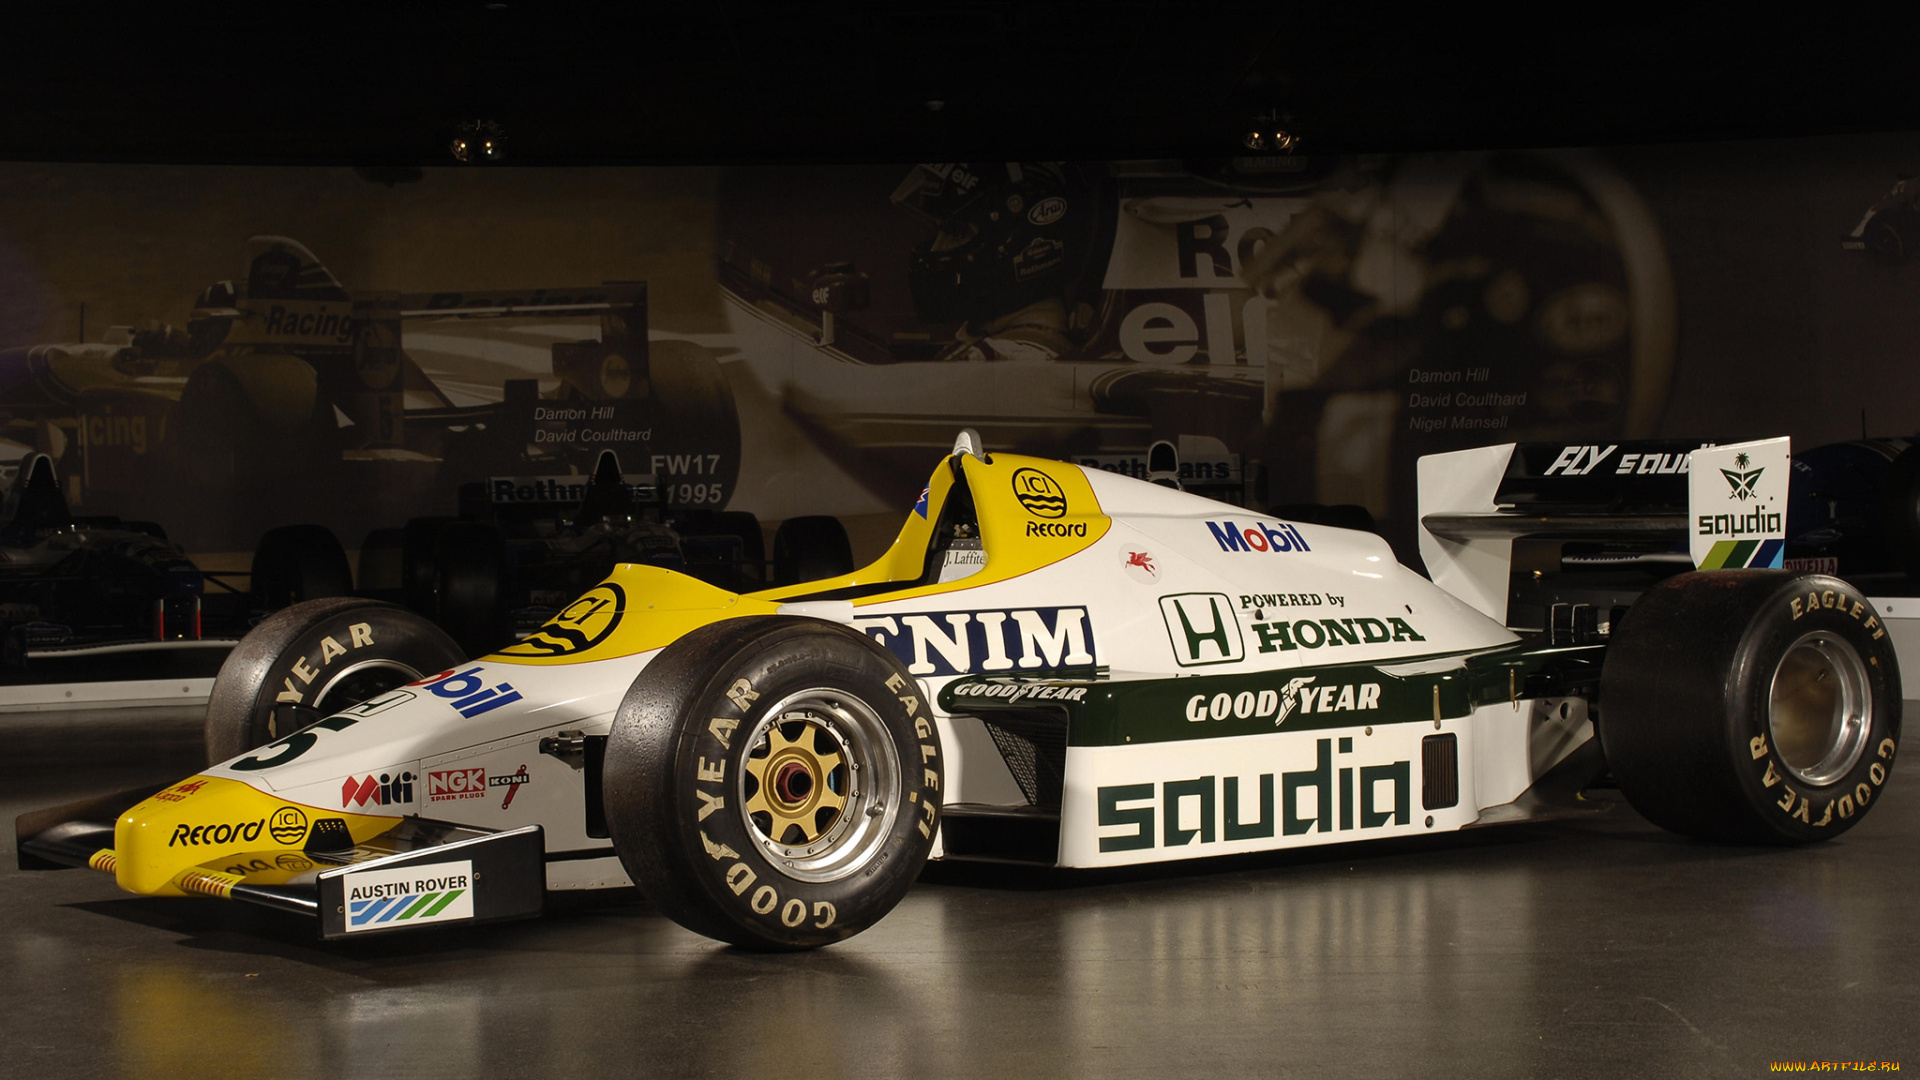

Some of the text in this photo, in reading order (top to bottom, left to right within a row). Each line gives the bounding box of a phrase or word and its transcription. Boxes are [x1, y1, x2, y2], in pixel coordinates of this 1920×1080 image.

[952, 169, 979, 190] elf
[812, 287, 830, 304] elf
[265, 305, 352, 343] Racing
[1409, 367, 1489, 383] Damon Hill
[1409, 391, 1527, 408] David Coulthard
[534, 406, 615, 420] Damon Hill
[1409, 415, 1508, 433] Nigel Mansell
[534, 428, 652, 442] David Coulthard
[651, 454, 720, 475] FW17
[1543, 445, 1618, 476] FLY
[665, 483, 723, 504] 1995
[1020, 475, 1052, 494] ICI
[1698, 504, 1781, 537] saudia
[1205, 521, 1311, 552] Mobil
[943, 551, 952, 568] J.
[1240, 593, 1345, 609] POWERED by
[1790, 590, 1865, 620] EAGLE
[1251, 617, 1426, 653] HONDA
[430, 769, 484, 795] NGK
[491, 775, 528, 786] KONI
[431, 792, 485, 802] SPARK PLUGS
[1097, 737, 1411, 853] saudia
[279, 813, 299, 826] ICI
[350, 875, 468, 900] AUSTIN ROVER
